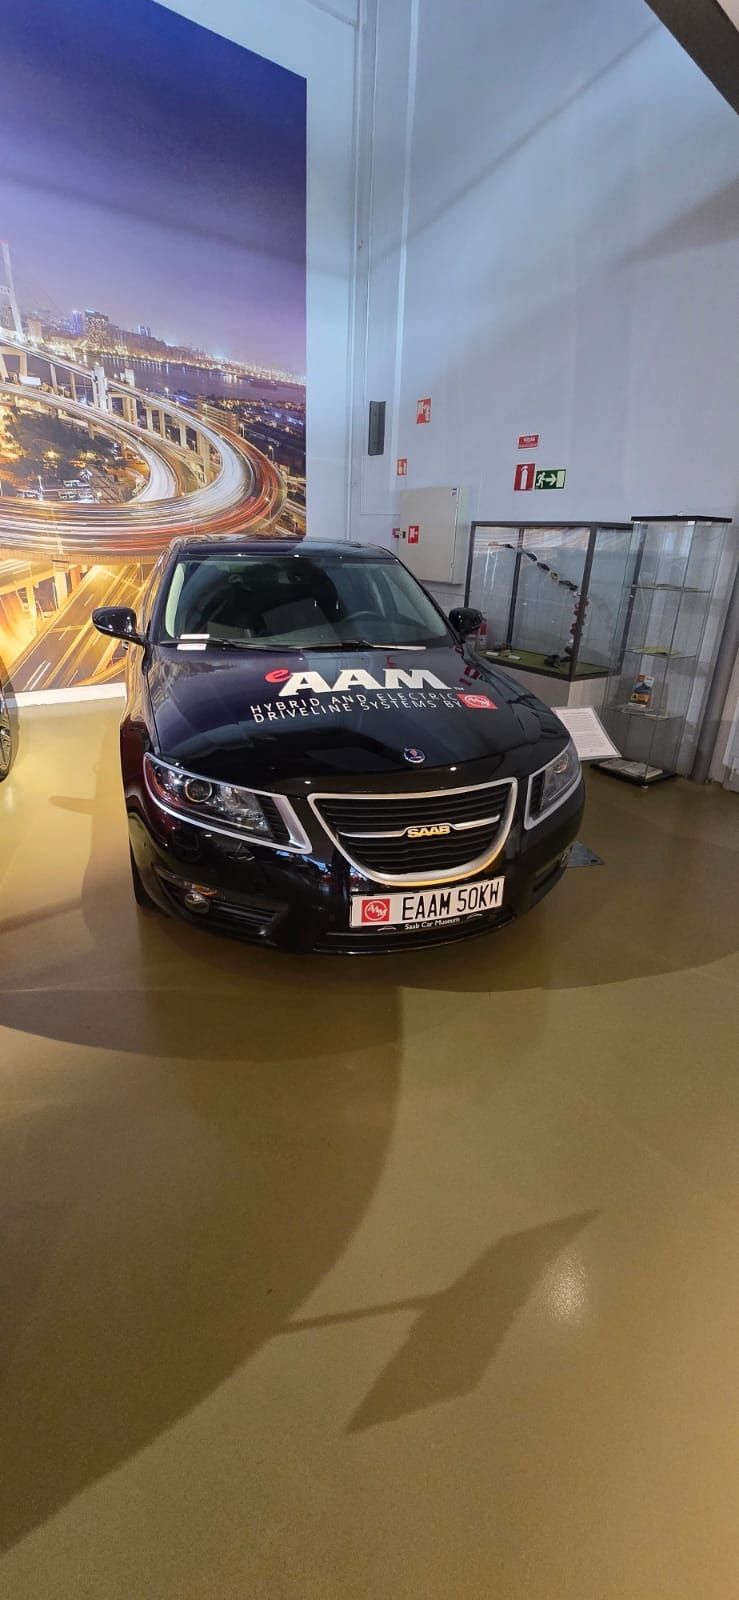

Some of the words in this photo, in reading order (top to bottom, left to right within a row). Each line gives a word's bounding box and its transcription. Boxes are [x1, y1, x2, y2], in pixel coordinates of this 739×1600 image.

[250, 698, 320, 715] HYBRID
[331, 694, 367, 705] AND
[376, 693, 457, 701] ELECTRIC
[253, 704, 353, 723] DRIVELINE
[360, 700, 437, 711] SYSTEMS
[443, 700, 462, 709] BY
[407, 825, 451, 839] SAAB
[402, 892, 451, 921] EAAM
[456, 883, 500, 912] 50KW
[404, 922, 420, 930] Saab
[434, 917, 461, 926] Museum
